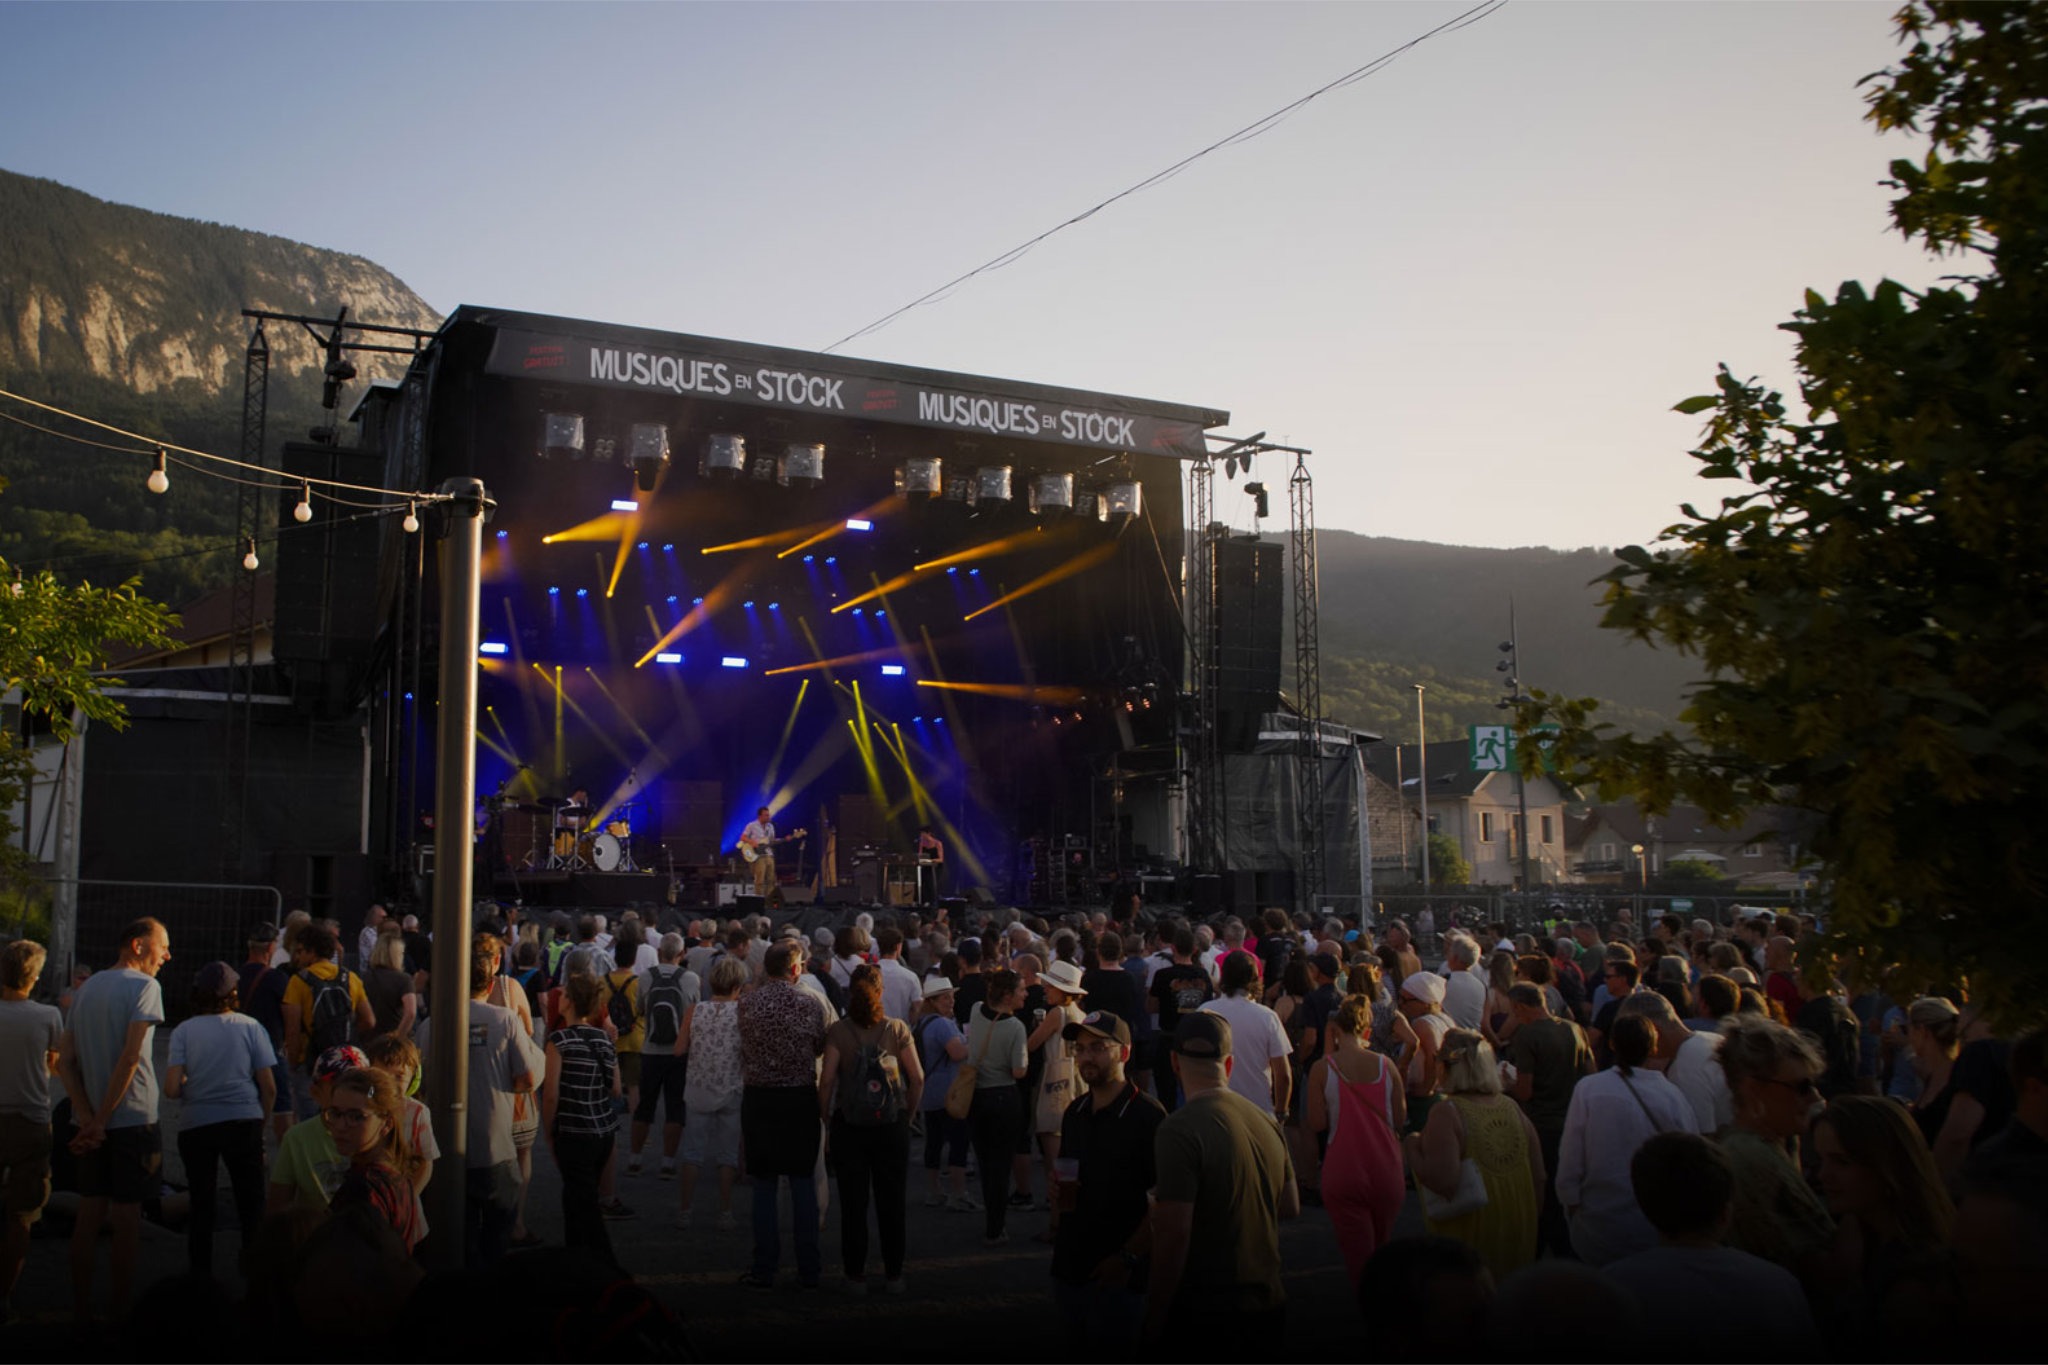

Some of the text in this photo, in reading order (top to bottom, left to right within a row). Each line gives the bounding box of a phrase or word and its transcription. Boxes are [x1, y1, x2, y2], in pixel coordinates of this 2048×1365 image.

[590, 347, 844, 409] MUSIQUES EN STOCK
[919, 391, 1040, 434] MUSIQUES
[1042, 415, 1057, 429] EN
[1060, 409, 1135, 446] STOCK
